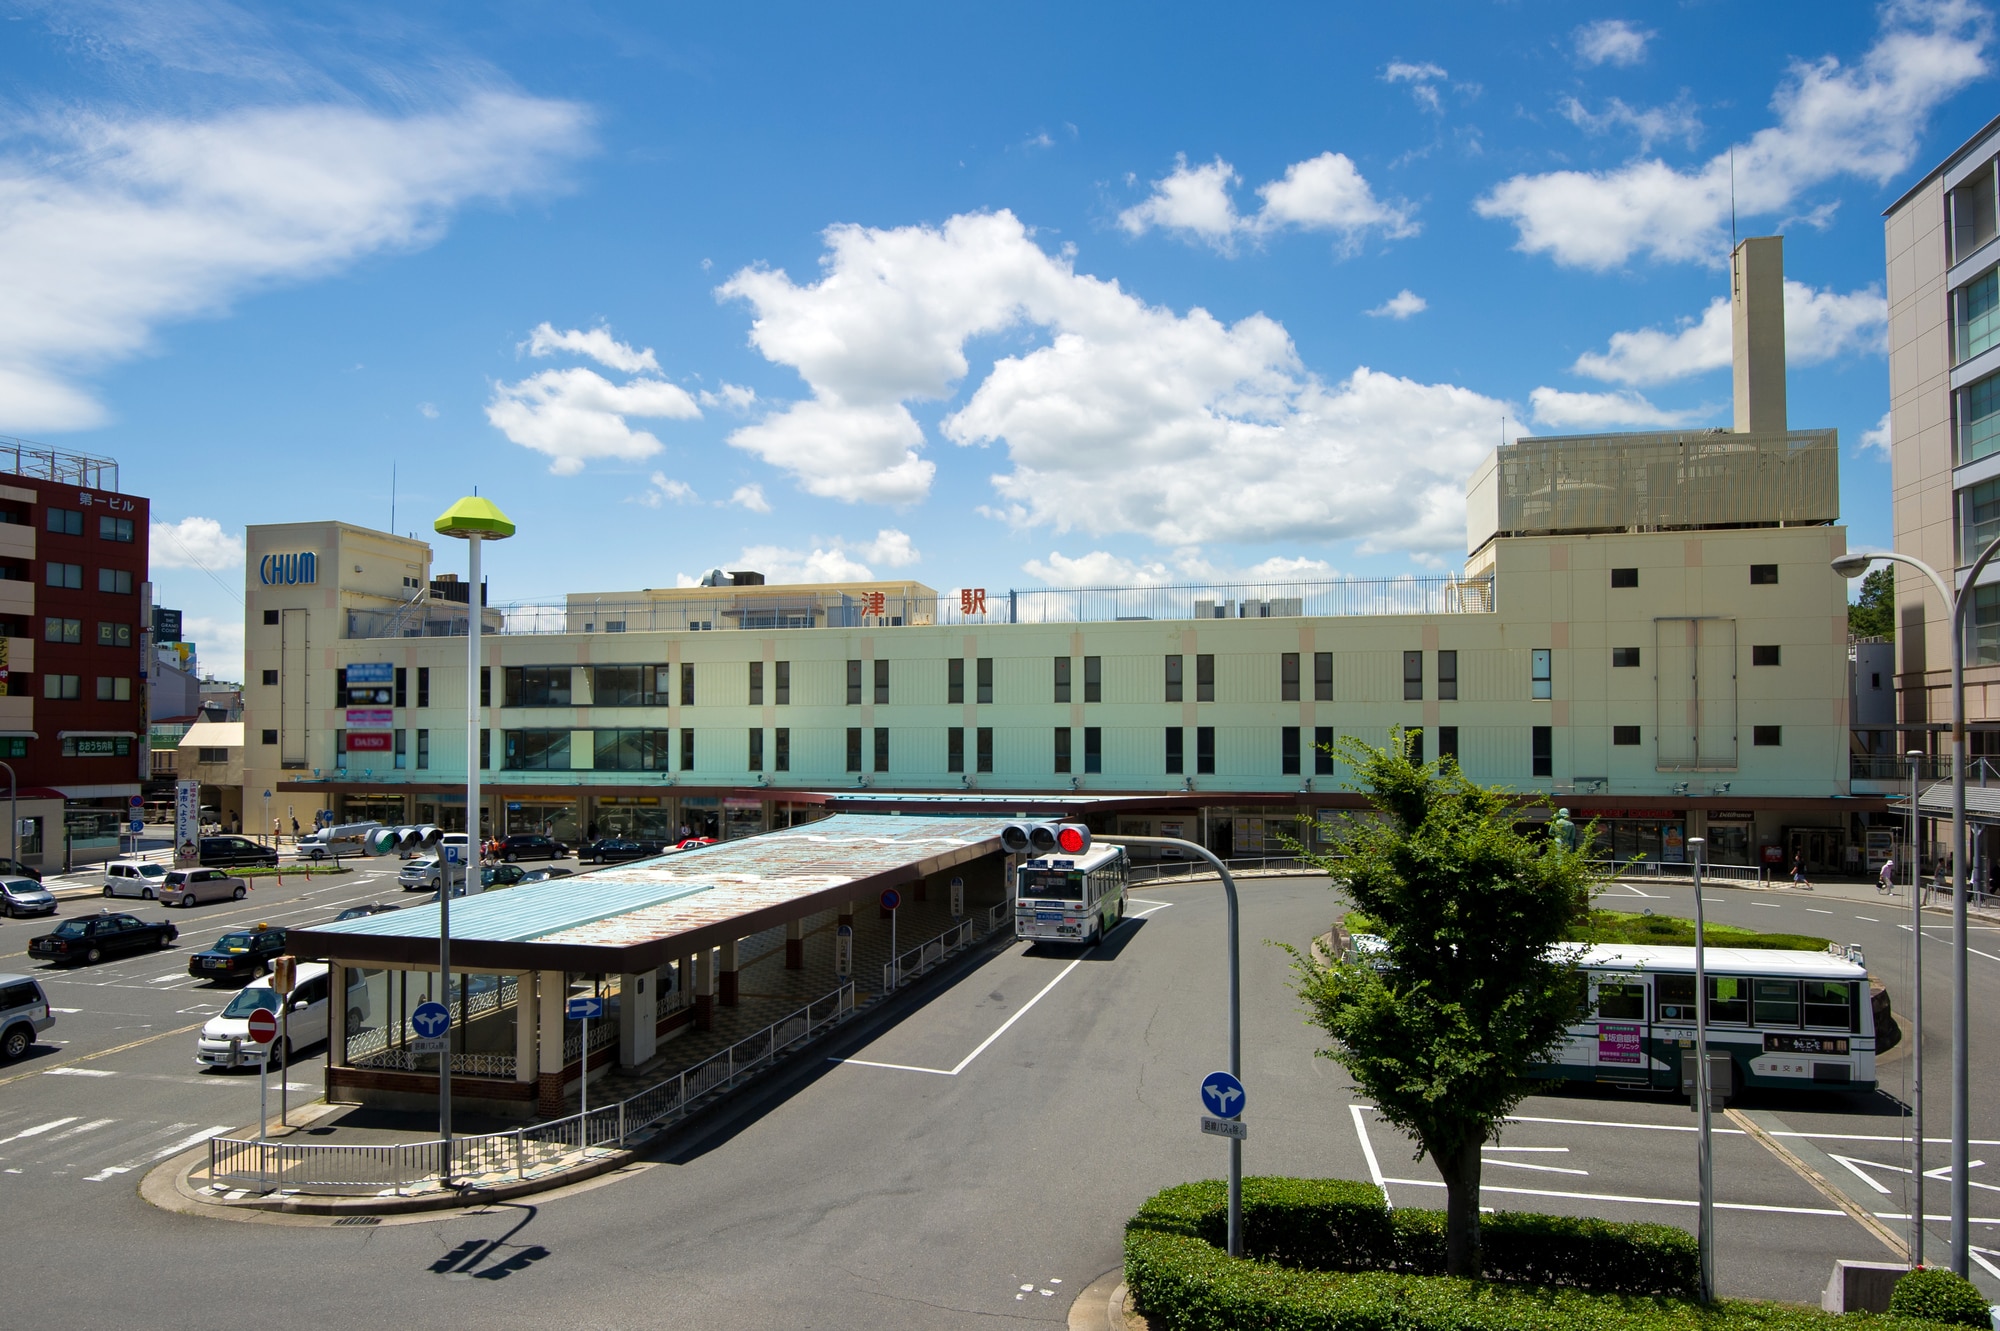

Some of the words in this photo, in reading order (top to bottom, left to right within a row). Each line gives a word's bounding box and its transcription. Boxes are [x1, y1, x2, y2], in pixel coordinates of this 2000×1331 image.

[85, 491, 134, 516] 第一ビル
[260, 552, 316, 585] CHUM
[861, 588, 986, 617] 津駅
[79, 741, 113, 751] おおうち内科
[354, 738, 384, 747] DAISO
[179, 788, 189, 838] 津市へようこそ
[448, 848, 456, 862] P
[1608, 1033, 1640, 1043] 坂倉眼科
[415, 1041, 448, 1050] 路線バスを除く
[1758, 1063, 1803, 1073] 三重交通
[1204, 1120, 1243, 1136] 路線バスを除く
